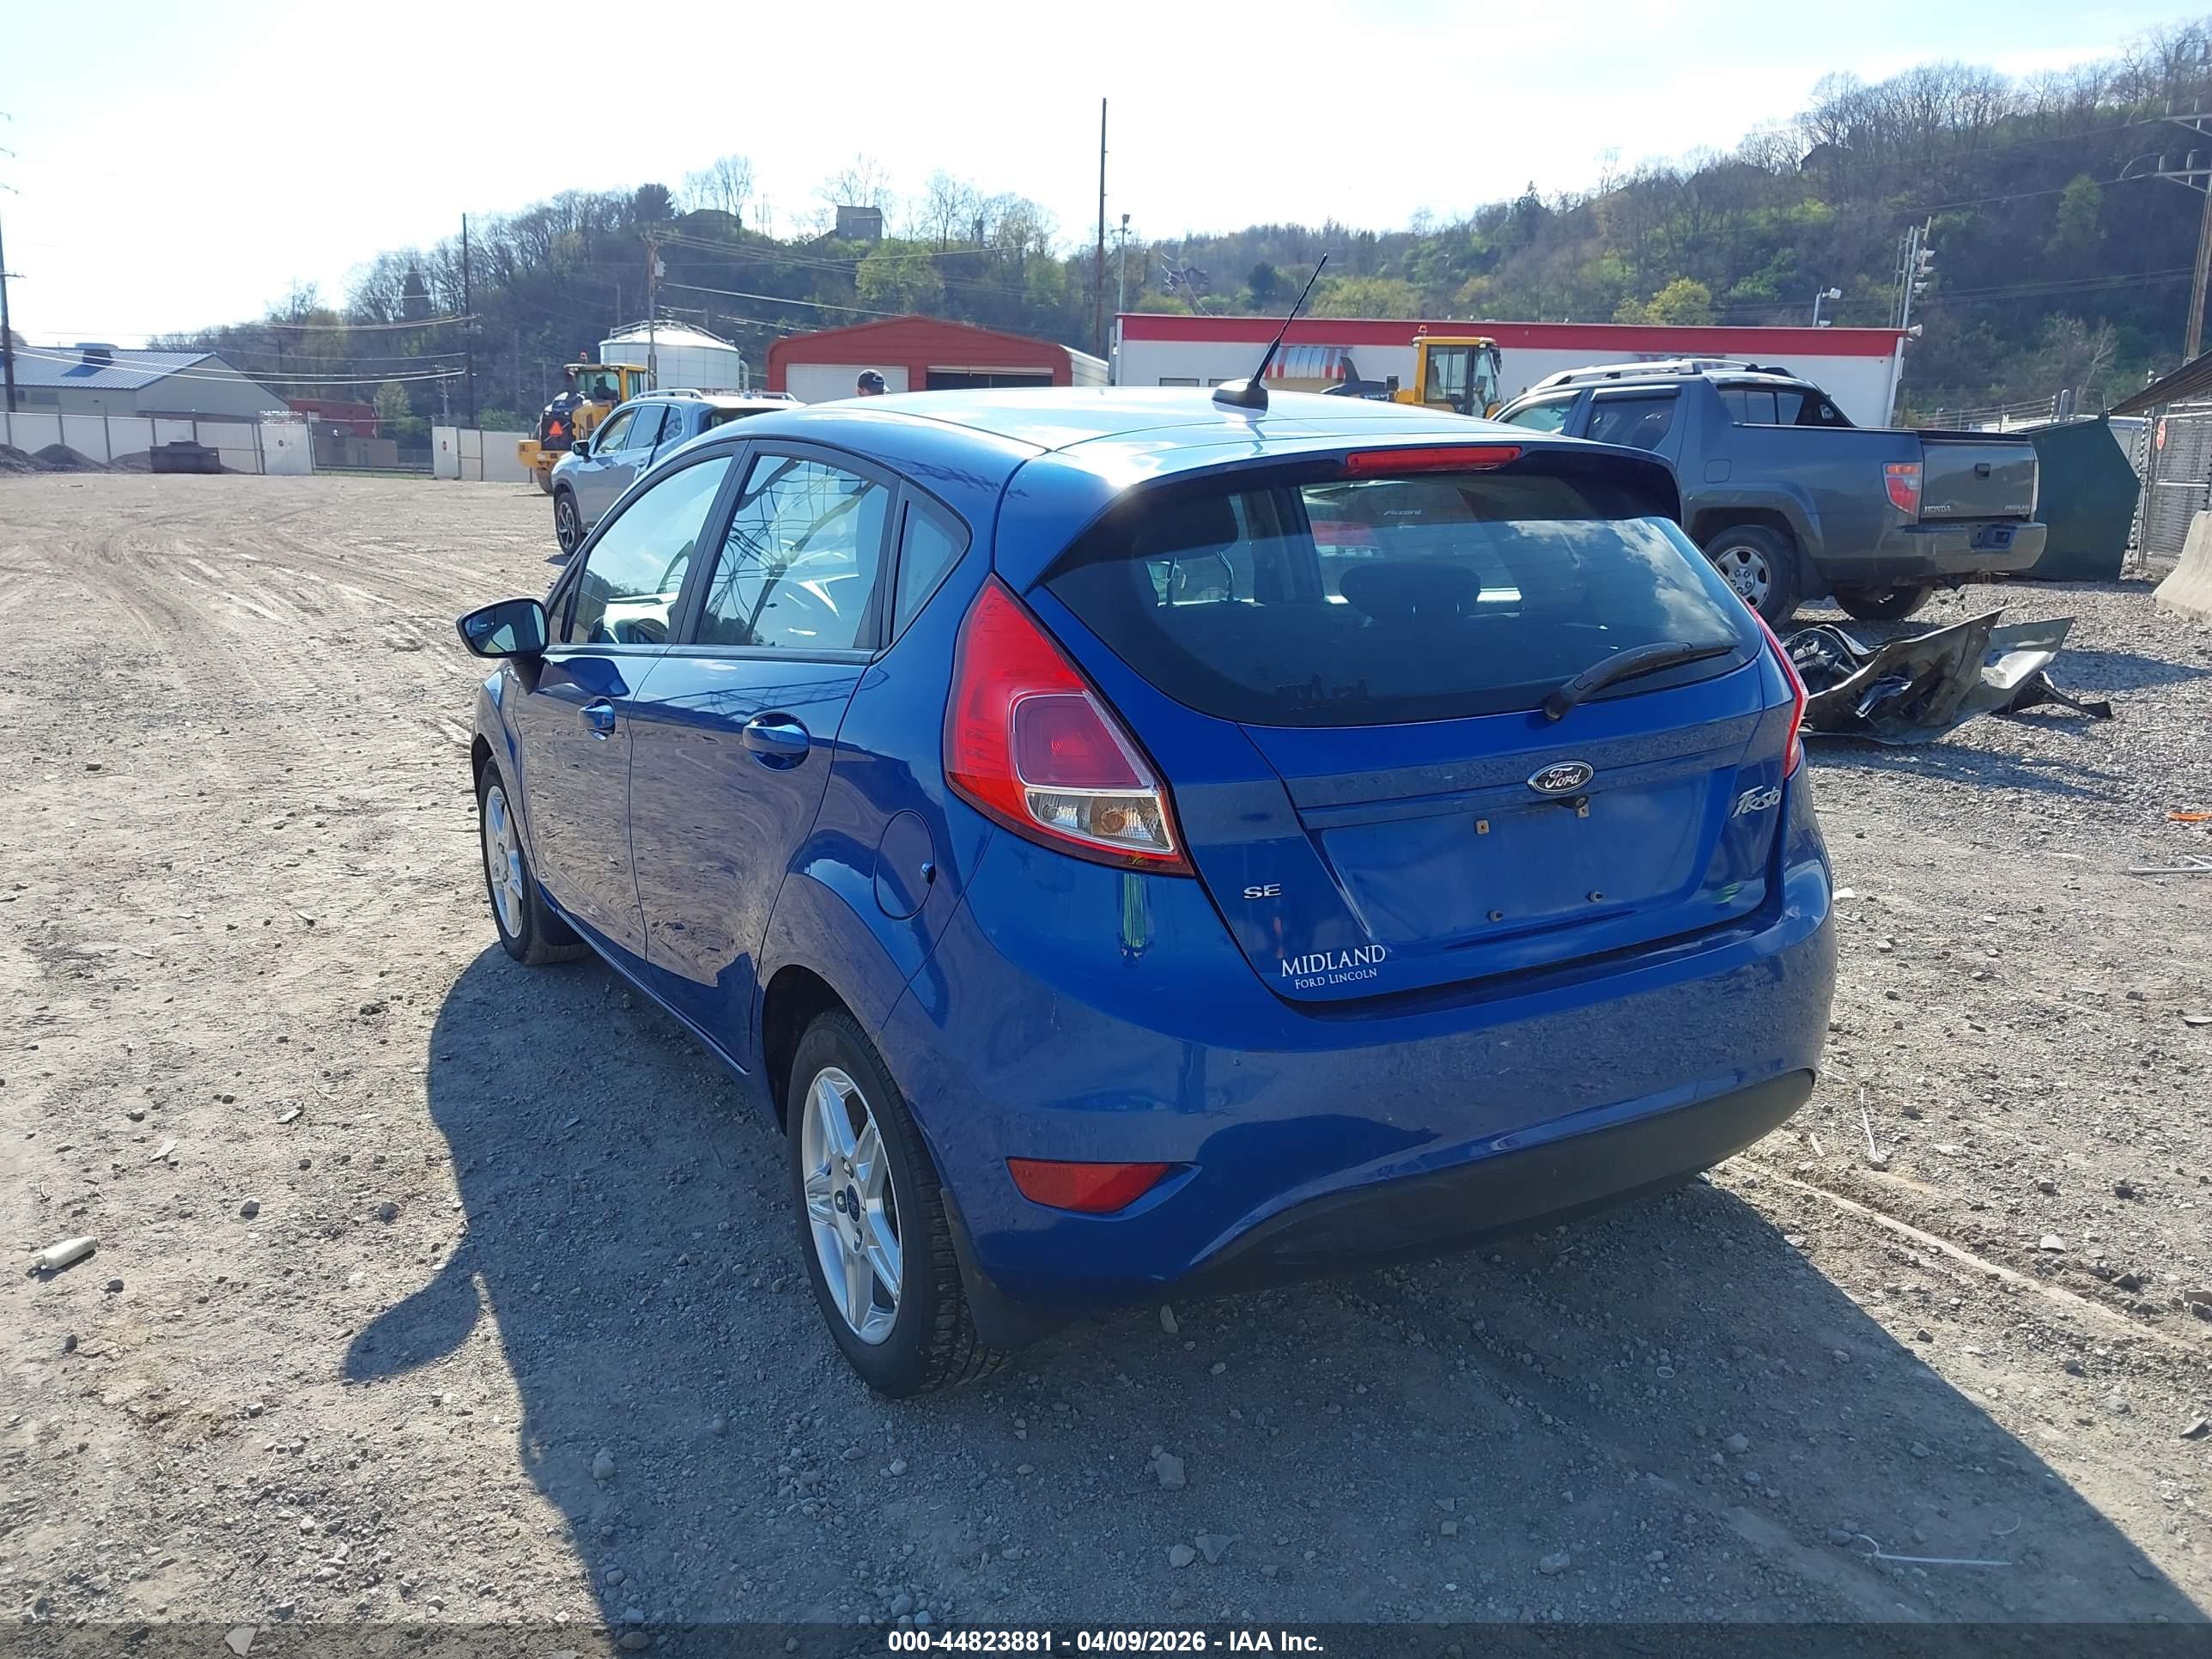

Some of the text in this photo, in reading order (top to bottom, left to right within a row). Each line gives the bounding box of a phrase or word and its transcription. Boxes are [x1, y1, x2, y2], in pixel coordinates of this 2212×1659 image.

[1924, 505, 1951, 514] HONDA
[1546, 767, 1582, 788] Ford
[1243, 883, 1282, 899] SE
[1281, 945, 1386, 977] MIDLAND
[1294, 968, 1377, 989] FORD LINCOLN
